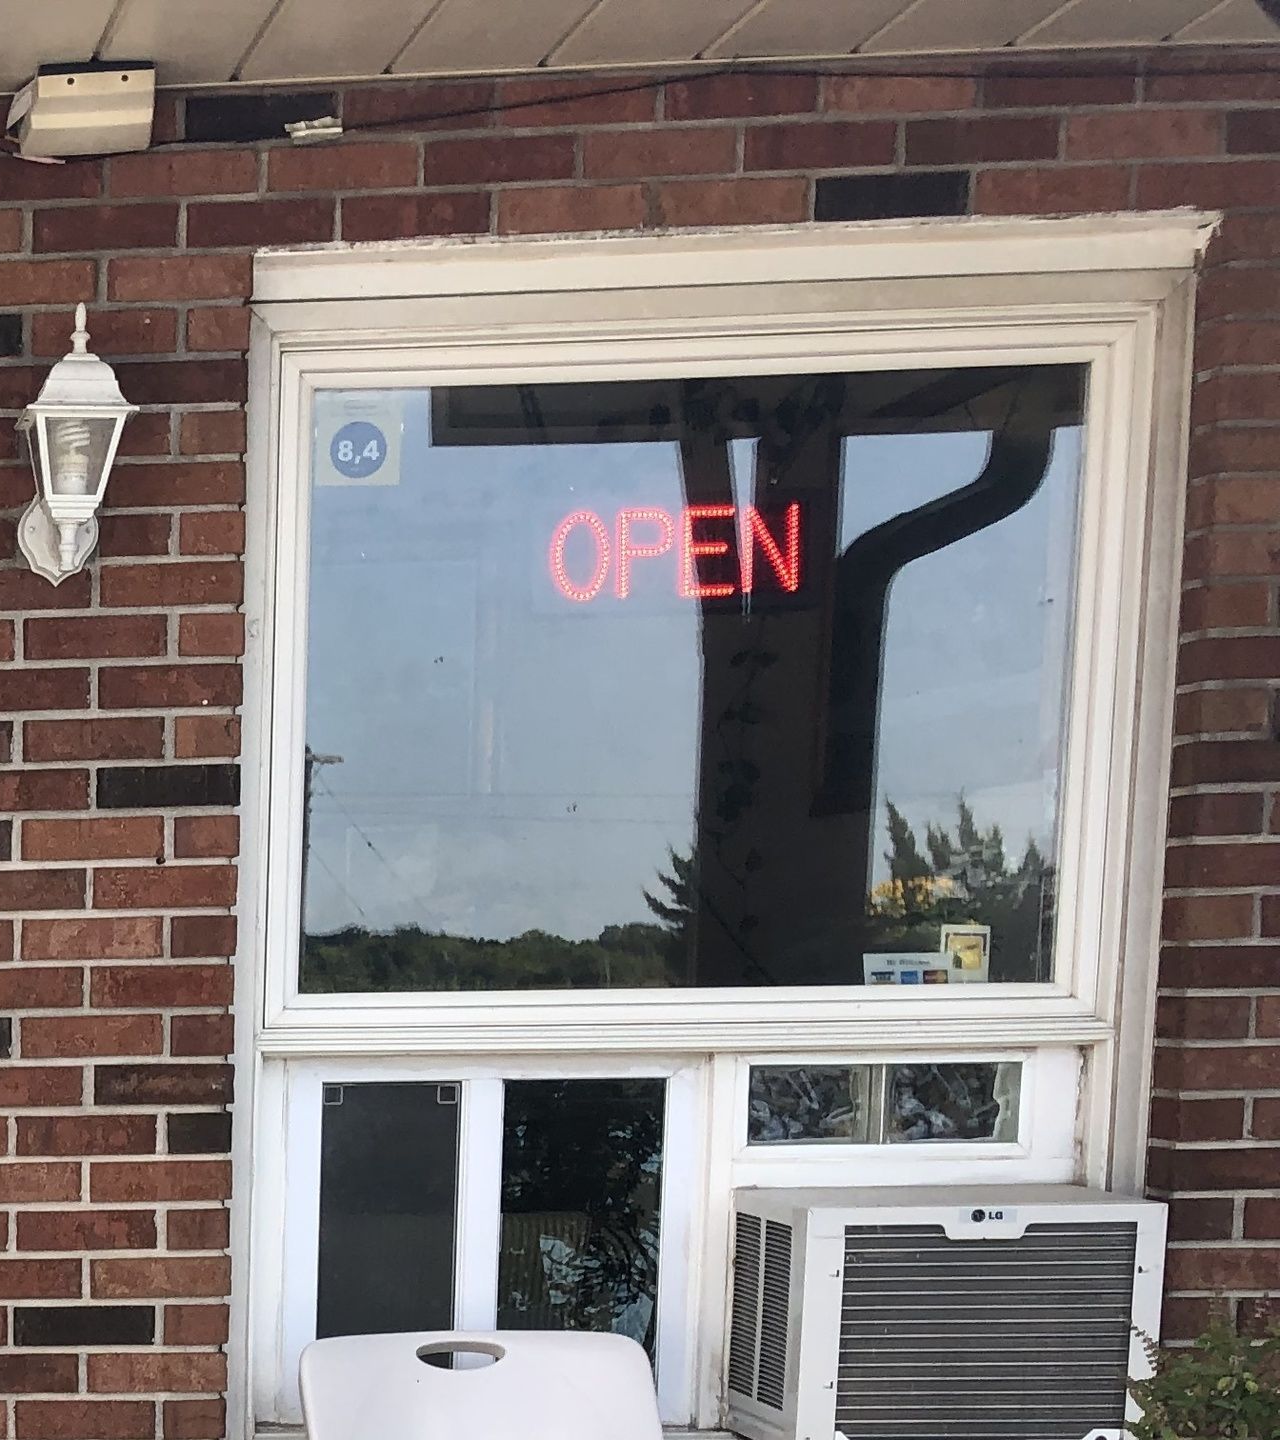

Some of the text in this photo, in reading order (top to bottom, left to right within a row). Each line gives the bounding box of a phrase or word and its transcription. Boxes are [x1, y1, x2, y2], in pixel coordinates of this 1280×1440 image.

[337, 439, 380, 465] 8,4
[550, 503, 802, 600] OPEN
[988, 1211, 1003, 1220] LG
